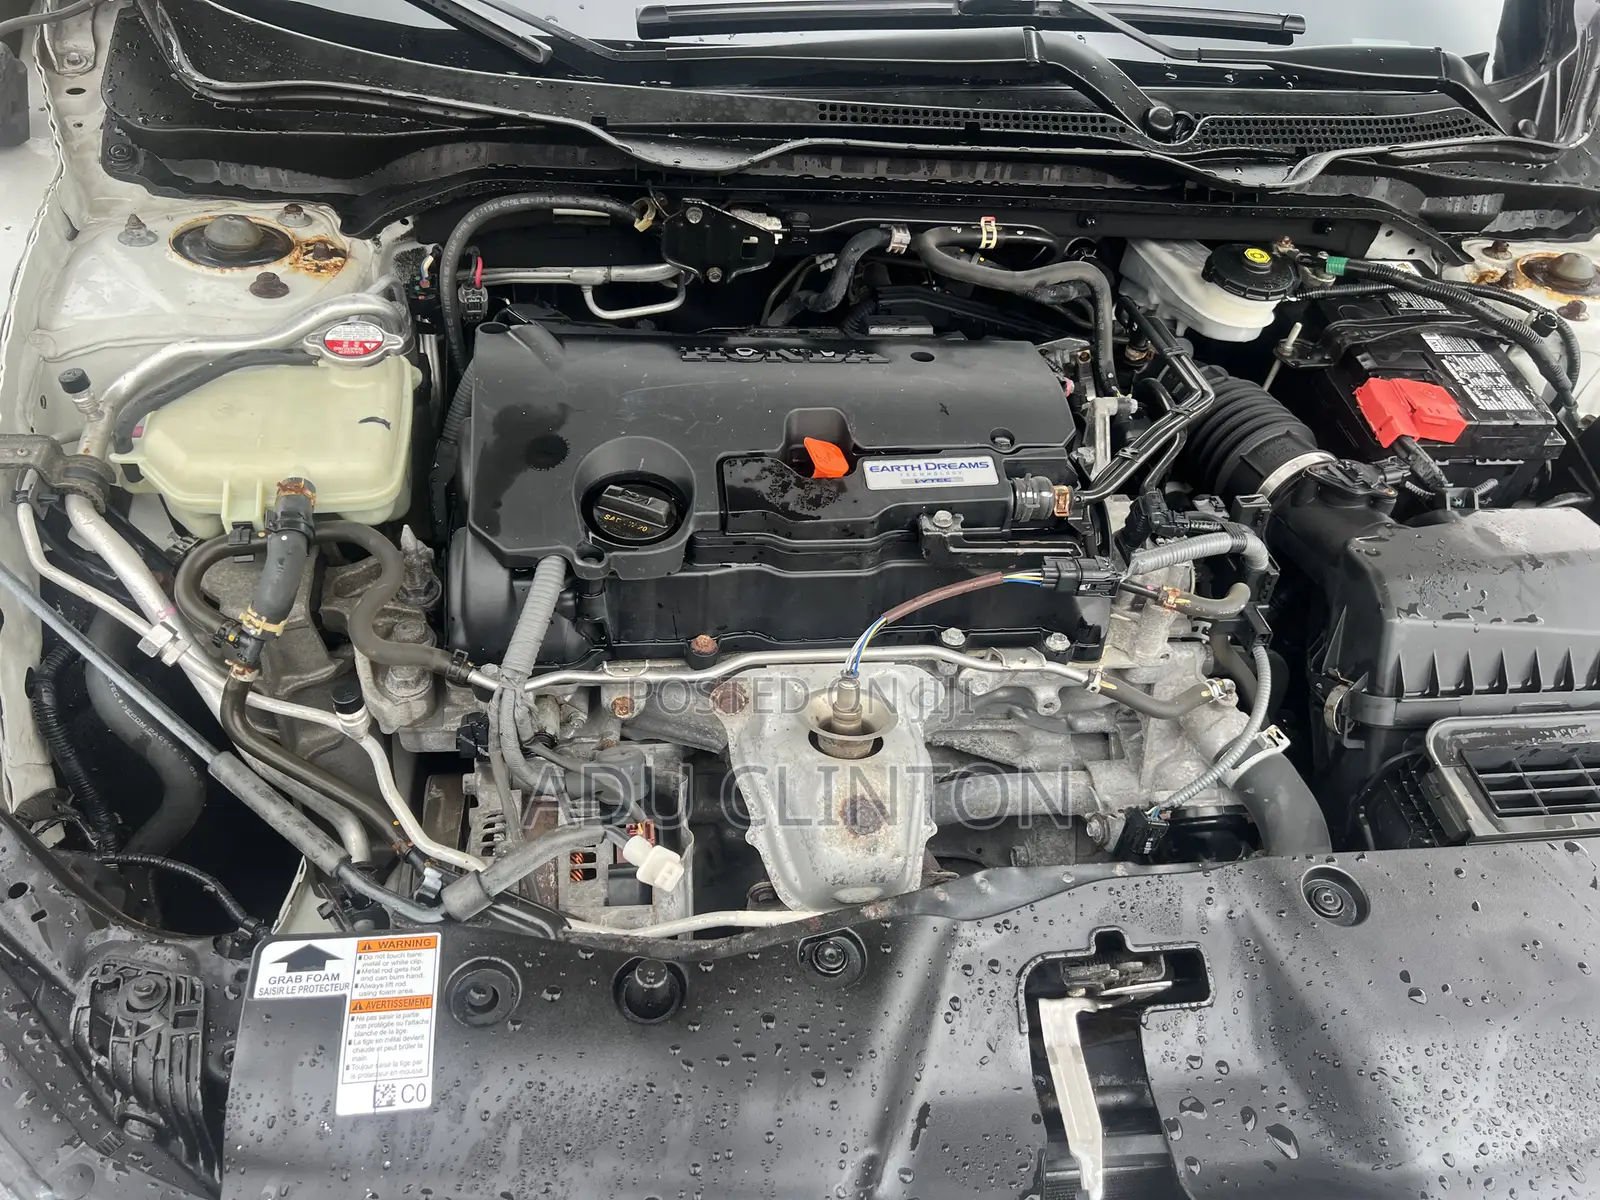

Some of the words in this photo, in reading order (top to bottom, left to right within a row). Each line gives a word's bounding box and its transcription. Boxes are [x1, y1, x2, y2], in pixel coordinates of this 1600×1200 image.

[679, 347, 891, 363] HONDA
[869, 464, 922, 472] EARTH
[924, 461, 990, 471] DREAMS
[378, 938, 432, 949] WARNING
[268, 974, 303, 985] GRAB
[306, 972, 340, 983] FOAM
[258, 986, 285, 996] SAISIR
[286, 985, 296, 995] LE
[297, 982, 350, 994] PROTECTEUR
[359, 982, 384, 990] Always
[365, 996, 430, 1011] AVERTISSEMENT
